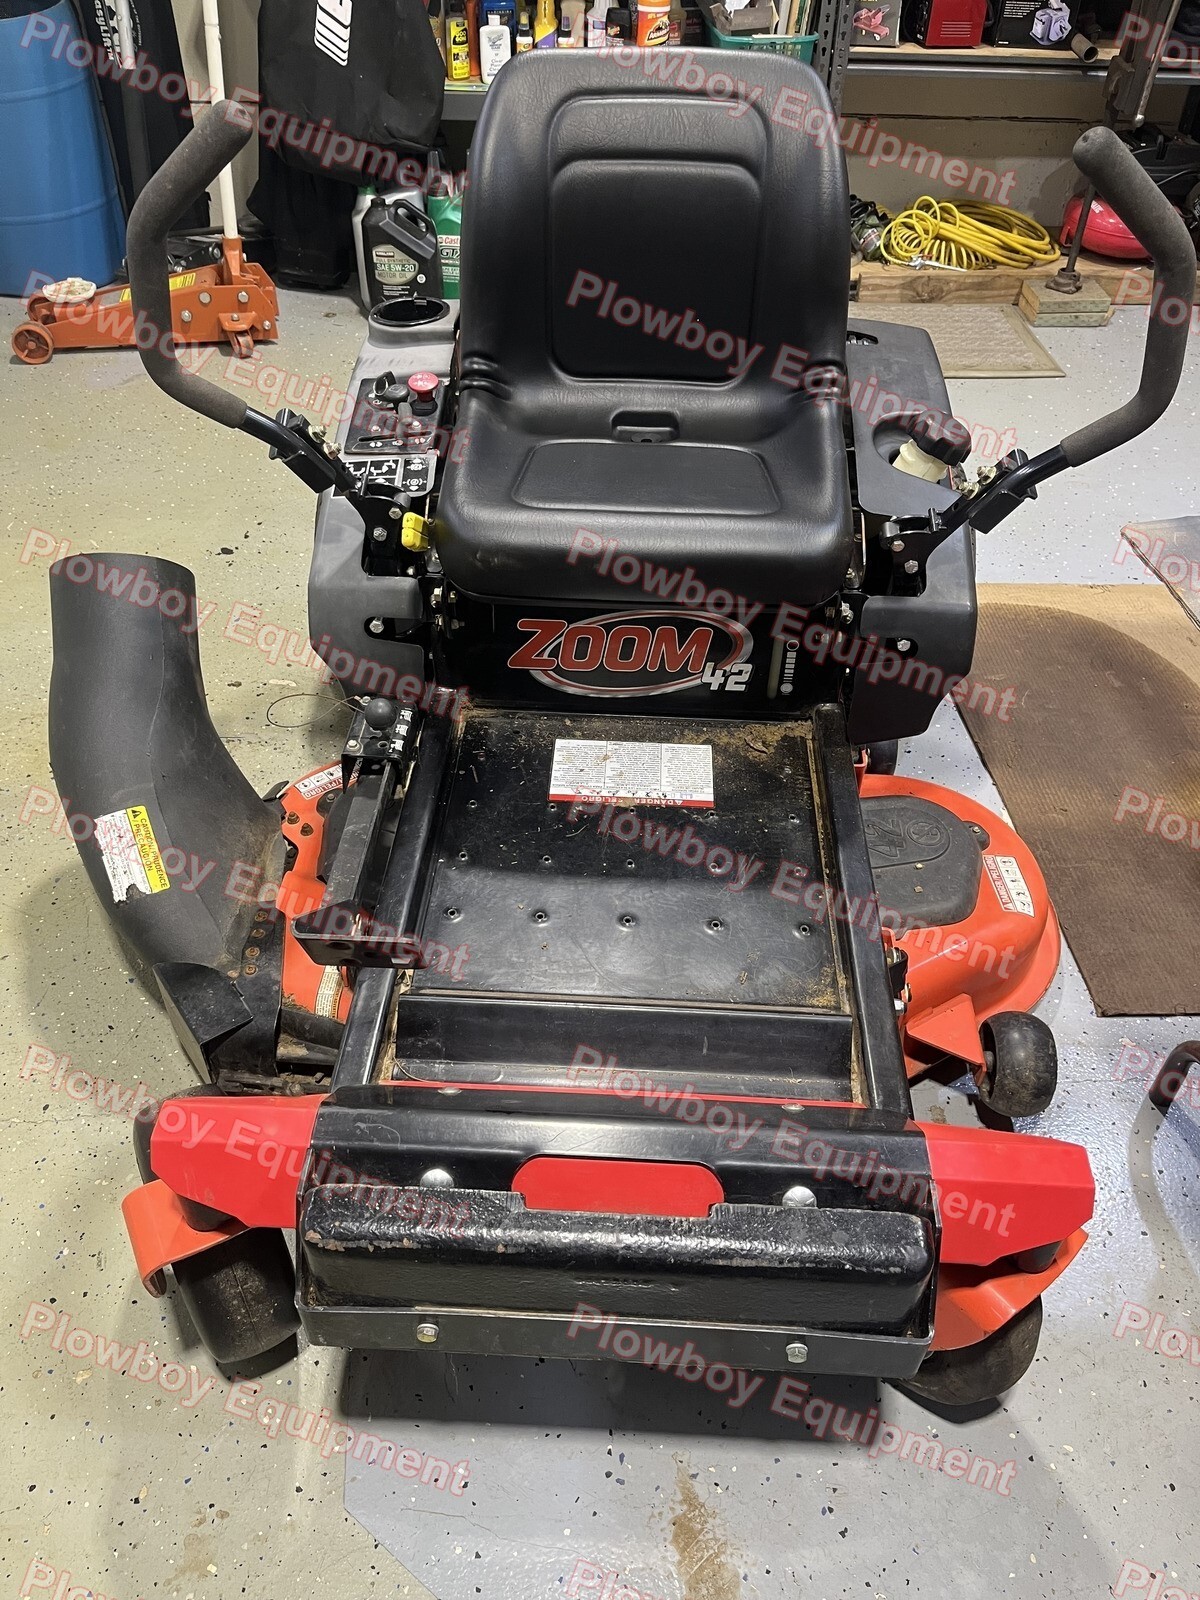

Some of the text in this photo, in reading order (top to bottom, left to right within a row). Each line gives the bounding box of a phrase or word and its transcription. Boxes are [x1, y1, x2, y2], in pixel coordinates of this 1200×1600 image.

[376, 263, 414, 272] SAE 5W-20
[507, 618, 713, 673] ZOOM
[701, 662, 753, 692] 42
[634, 797, 675, 806] DANGER
